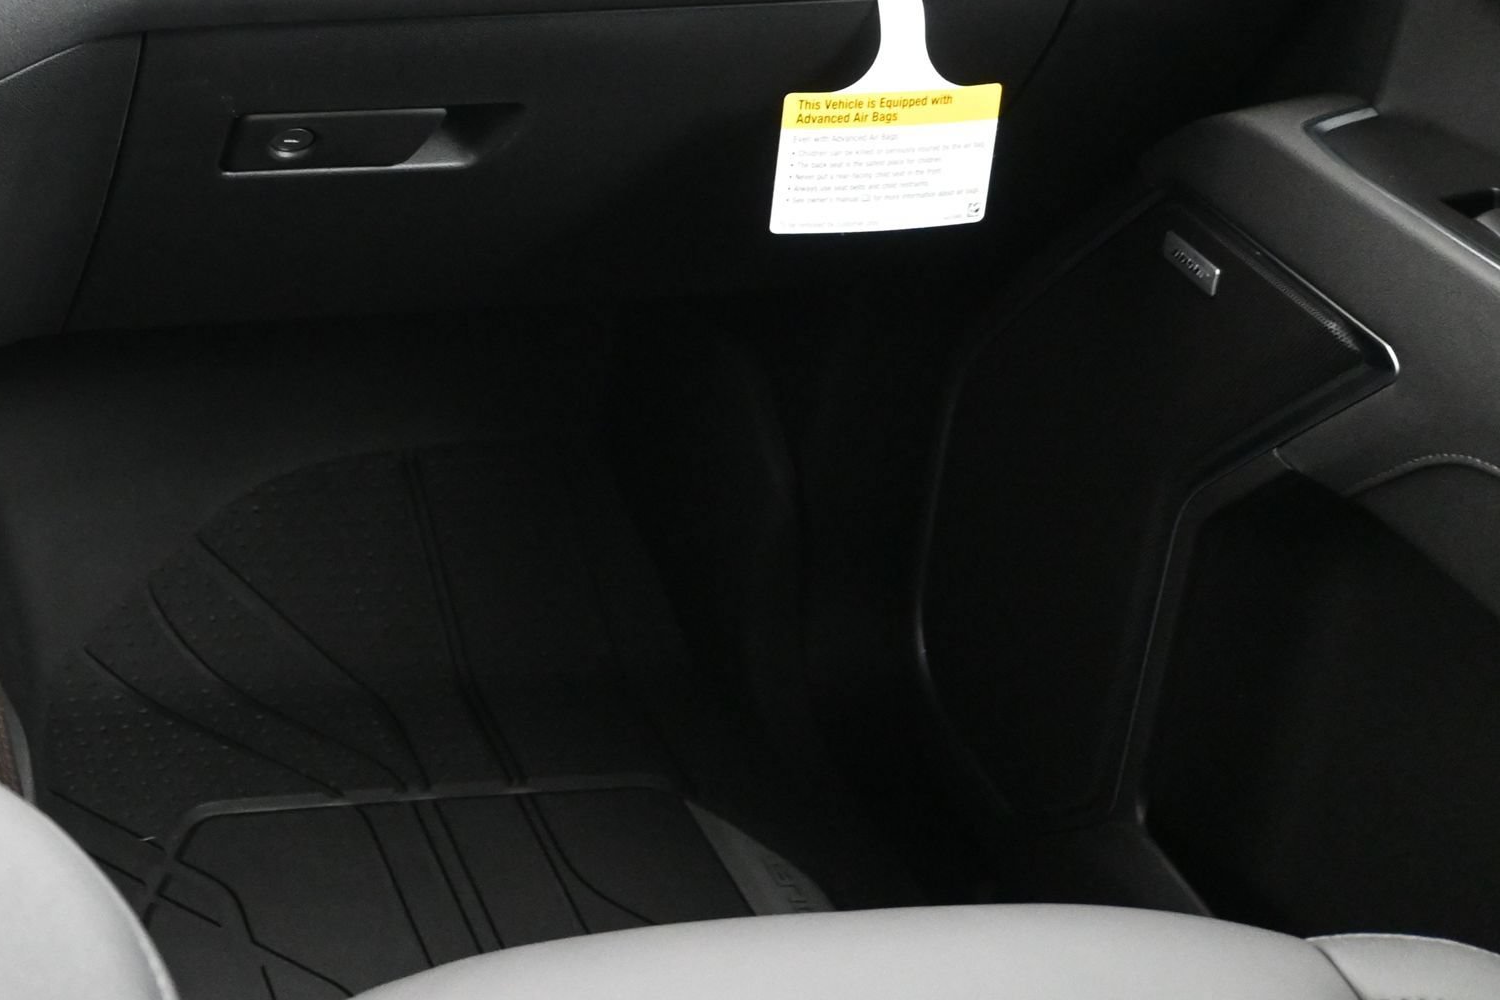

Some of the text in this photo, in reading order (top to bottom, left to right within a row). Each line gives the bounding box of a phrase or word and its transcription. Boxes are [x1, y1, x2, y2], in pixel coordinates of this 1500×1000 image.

[798, 94, 953, 110] This Vehicle is Equipped with
[796, 111, 898, 124] Advanced Air Bags
